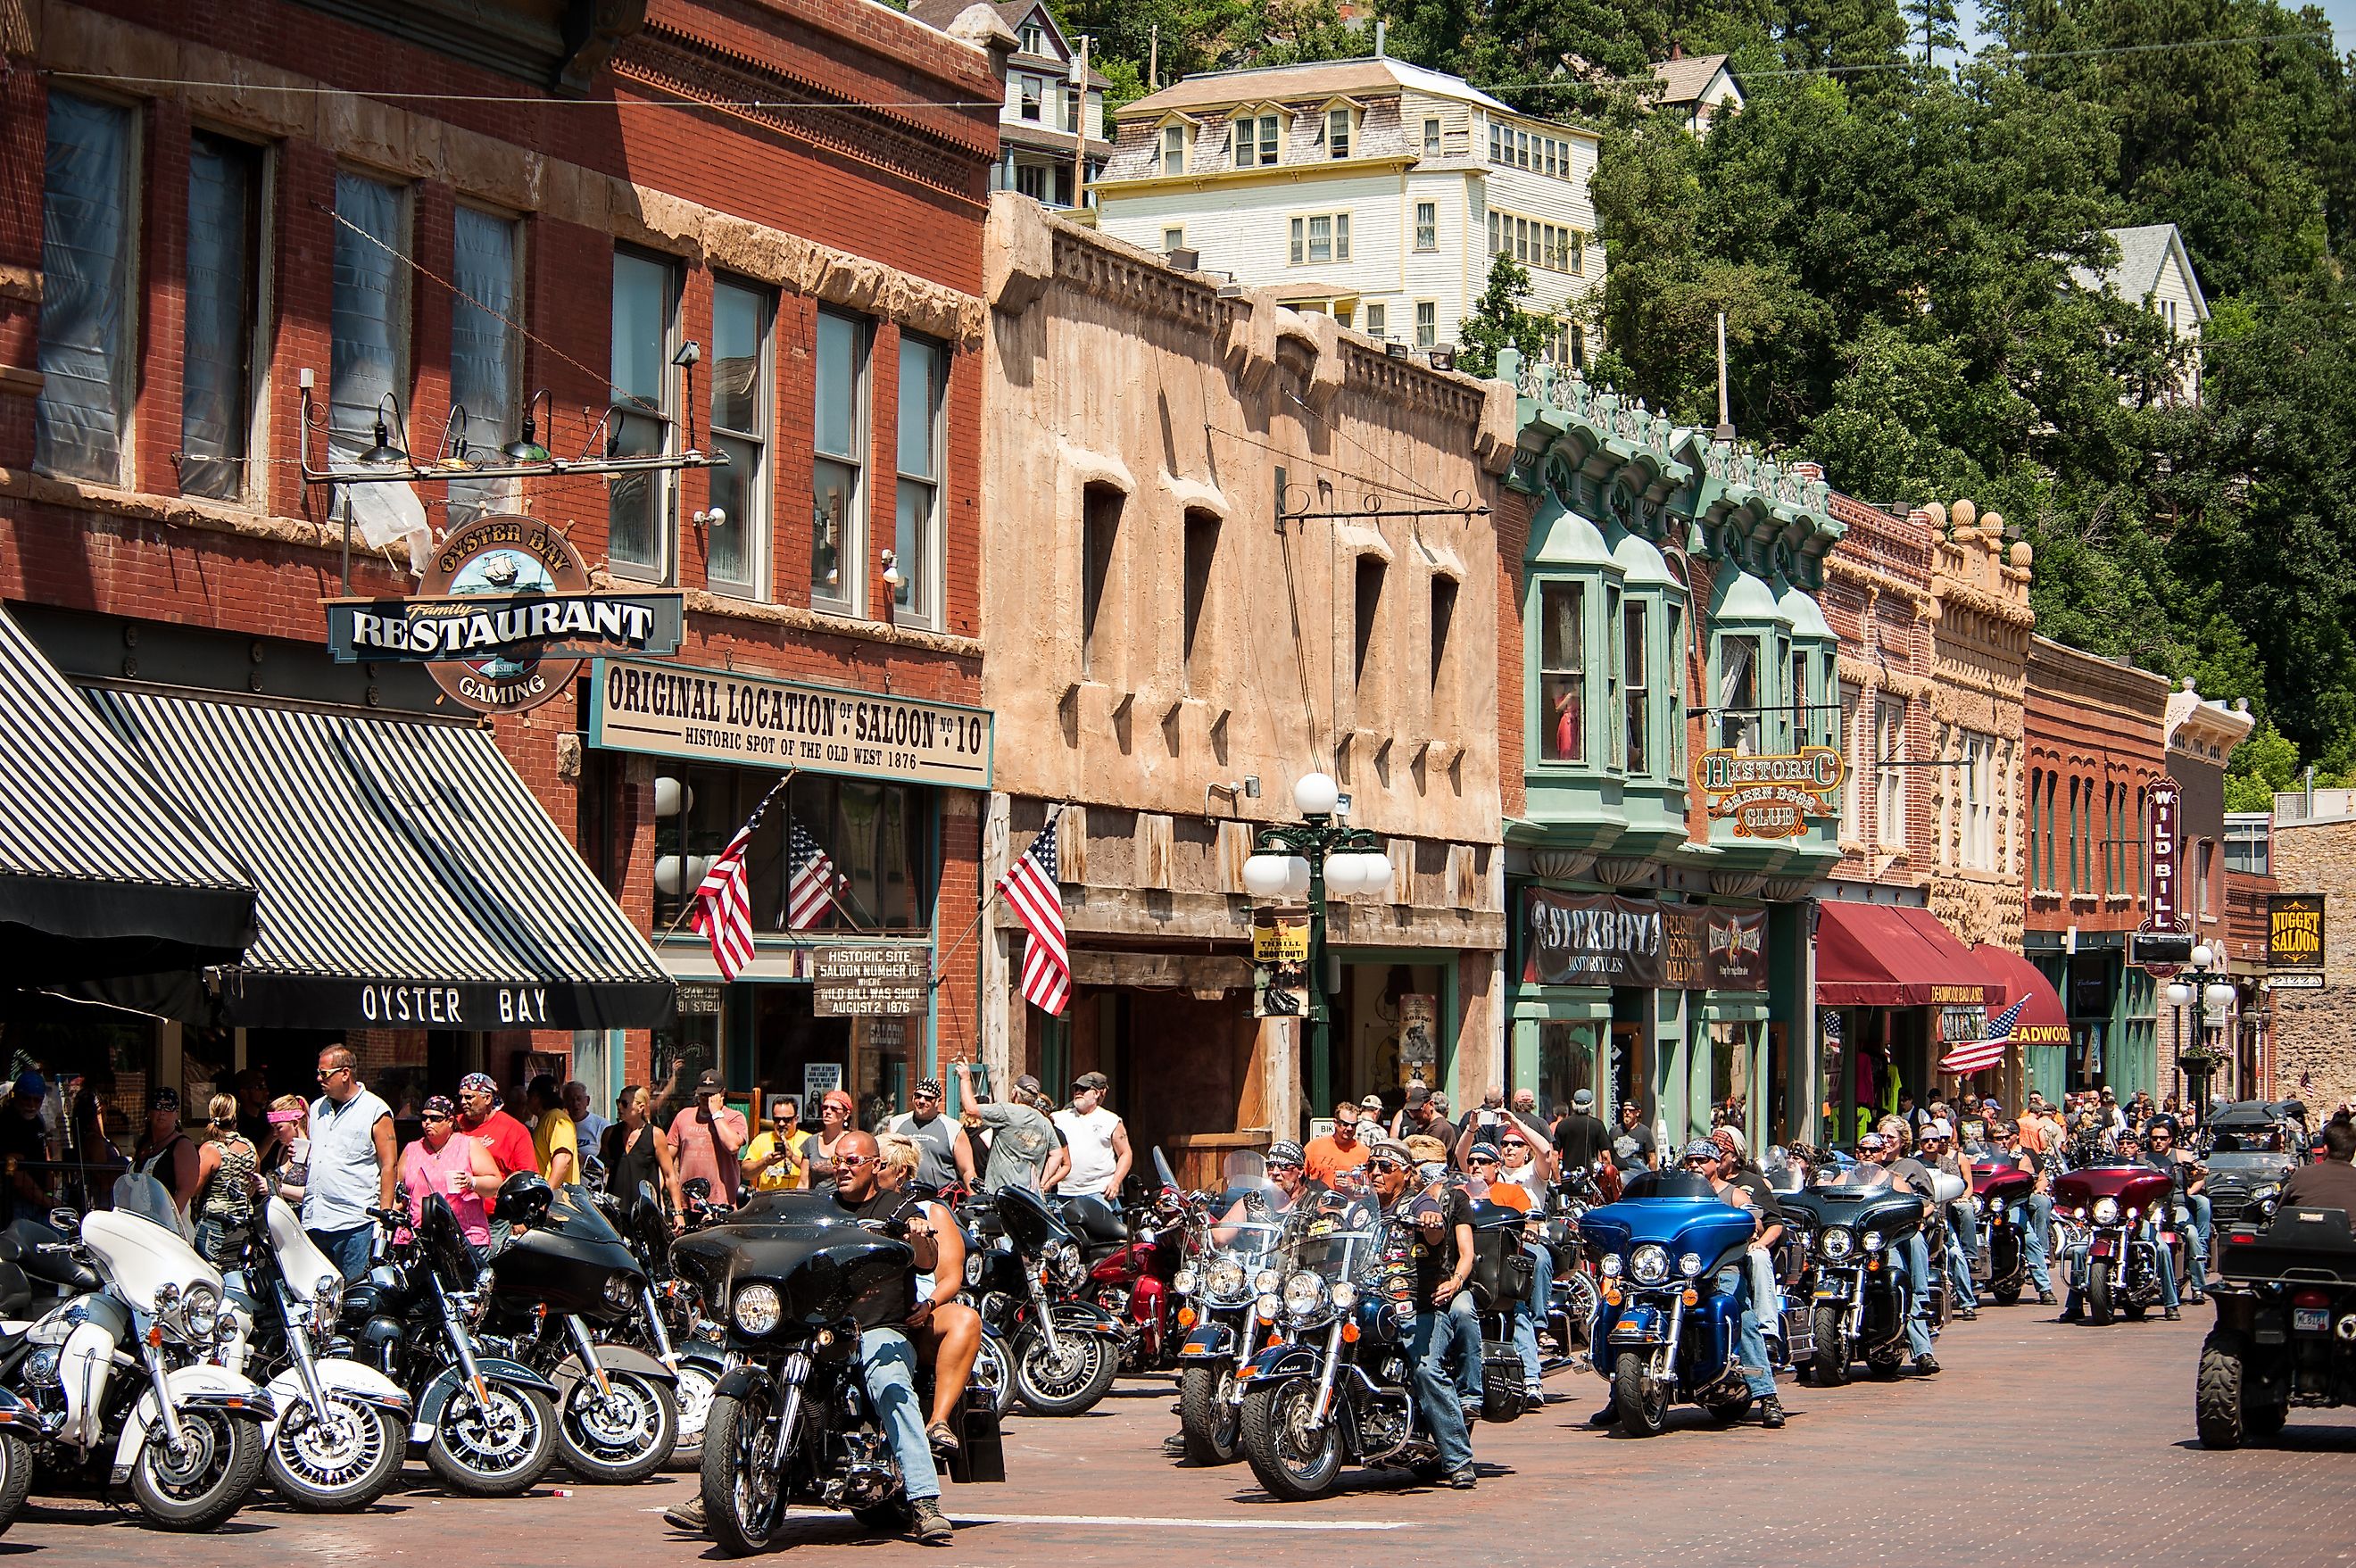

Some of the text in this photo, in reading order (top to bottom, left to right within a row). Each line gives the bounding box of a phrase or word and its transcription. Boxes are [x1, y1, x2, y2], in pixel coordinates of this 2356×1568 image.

[439, 523, 573, 574] OYSTER BAY
[404, 602, 488, 619] Family
[352, 600, 654, 653] RESTAURANT
[488, 664, 513, 673] SUSHI
[458, 673, 548, 705] GAMING
[608, 666, 721, 723] ORIGINAL
[726, 683, 837, 737] LOCATION
[839, 701, 854, 719] OF
[855, 701, 937, 749] SALOON
[956, 715, 982, 755] 10
[684, 726, 917, 770] HISTORIC SPOT OF THE OLD WEST 1876
[1704, 752, 1836, 788] HISTORIC
[1722, 786, 1816, 813] GREEN DOOR
[1745, 807, 1795, 827] CLUB
[2154, 791, 2172, 927] WILD BILL
[1548, 907, 1648, 954] SICKBOY
[2271, 911, 2320, 935] NUGGET
[2271, 928, 2319, 952] SALOON
[828, 950, 911, 962] HISTORIC SITE
[1568, 955, 1624, 973] MOTORCYCLES
[820, 965, 919, 977] SALOON NUMBER 10
[858, 978, 882, 986] WHERE
[2272, 976, 2321, 985] PIZZA
[362, 984, 546, 1023] OYSTER BAY
[821, 988, 920, 1000] WILD BILL WAS SHOT
[832, 1001, 872, 1014] AUGUST
[887, 1001, 910, 1014] 1876
[2009, 1026, 2070, 1043] EADWOOD
